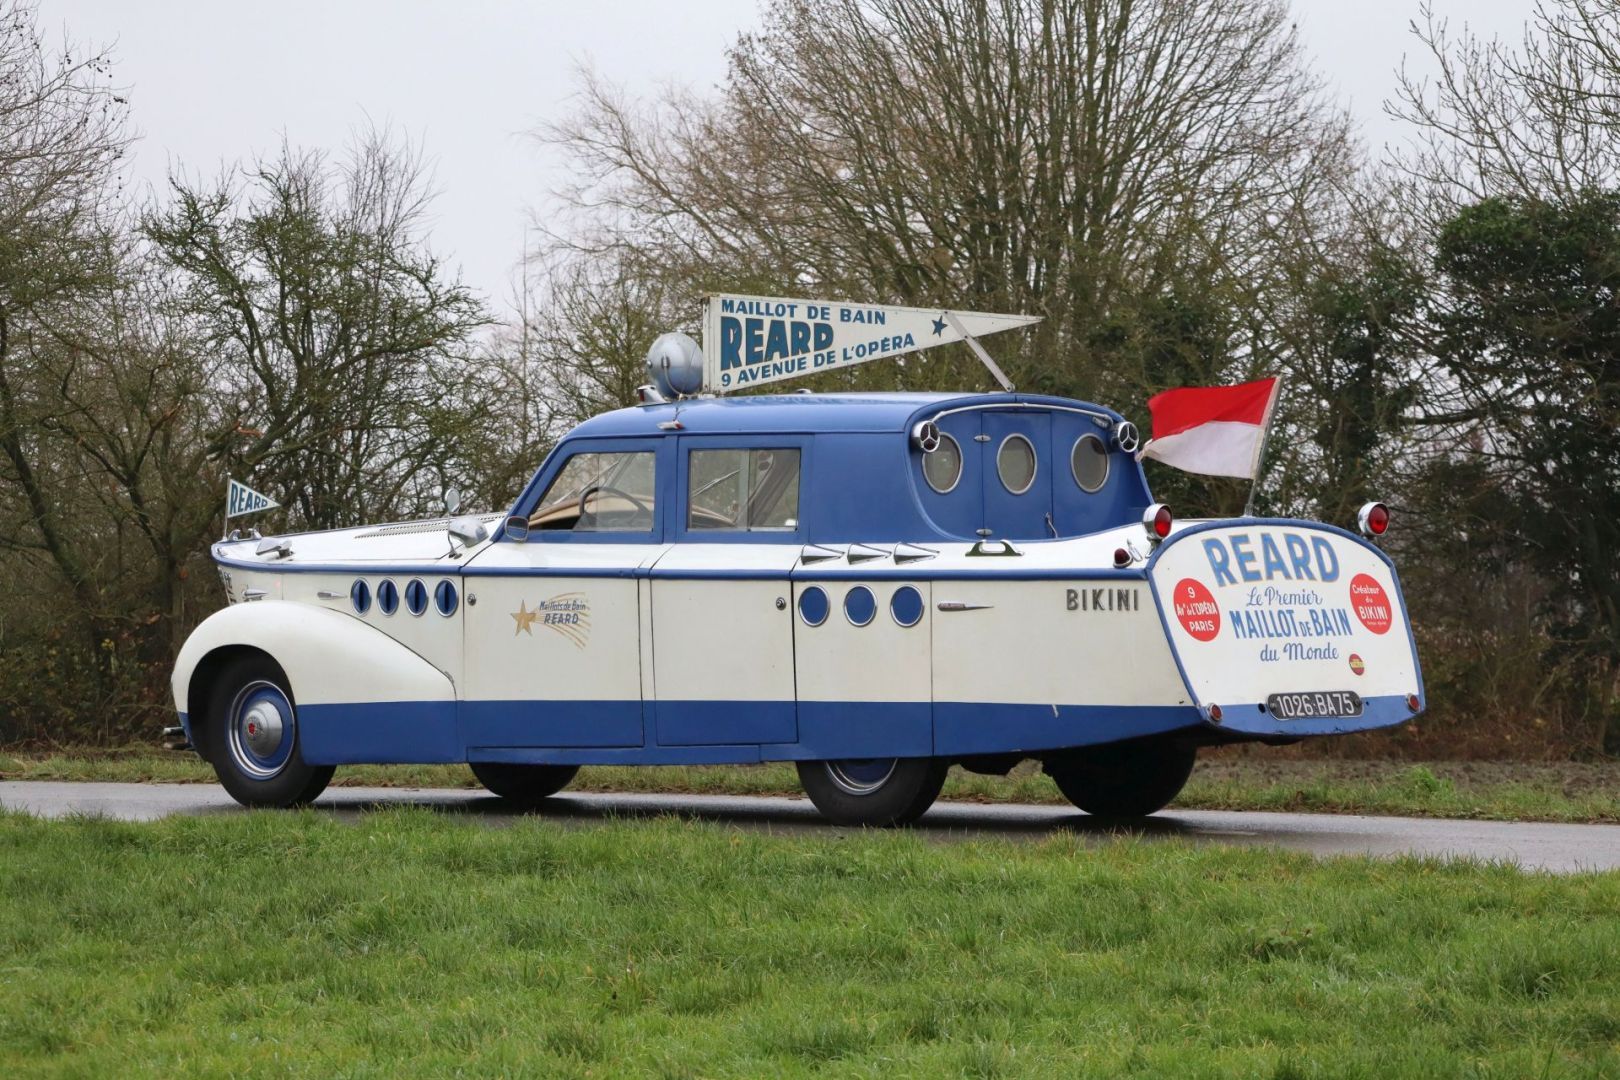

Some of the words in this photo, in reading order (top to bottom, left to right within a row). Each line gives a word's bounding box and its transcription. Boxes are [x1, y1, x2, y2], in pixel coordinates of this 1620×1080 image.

[721, 299, 798, 318] MAILLOT
[807, 305, 830, 321] DE
[840, 308, 886, 325] BAIN
[721, 316, 834, 371] REARD
[721, 373, 731, 387] 9
[737, 357, 807, 384] AVENUE
[814, 350, 836, 367] DE
[229, 483, 268, 515] REARD
[1201, 532, 1340, 588] REARD
[1066, 588, 1139, 611] BIKINI
[1187, 586, 1196, 599] 9
[1246, 586, 1263, 606] Le
[1264, 585, 1323, 606] Premier
[544, 613, 579, 624] REARD
[1229, 609, 1299, 639] MAILLOT
[1298, 621, 1313, 637] DE
[1308, 608, 1353, 637] BAIN
[1358, 606, 1388, 620] BIKINI
[1189, 620, 1215, 632] PARIS
[1260, 643, 1280, 662] du
[1283, 641, 1339, 661] Monde
